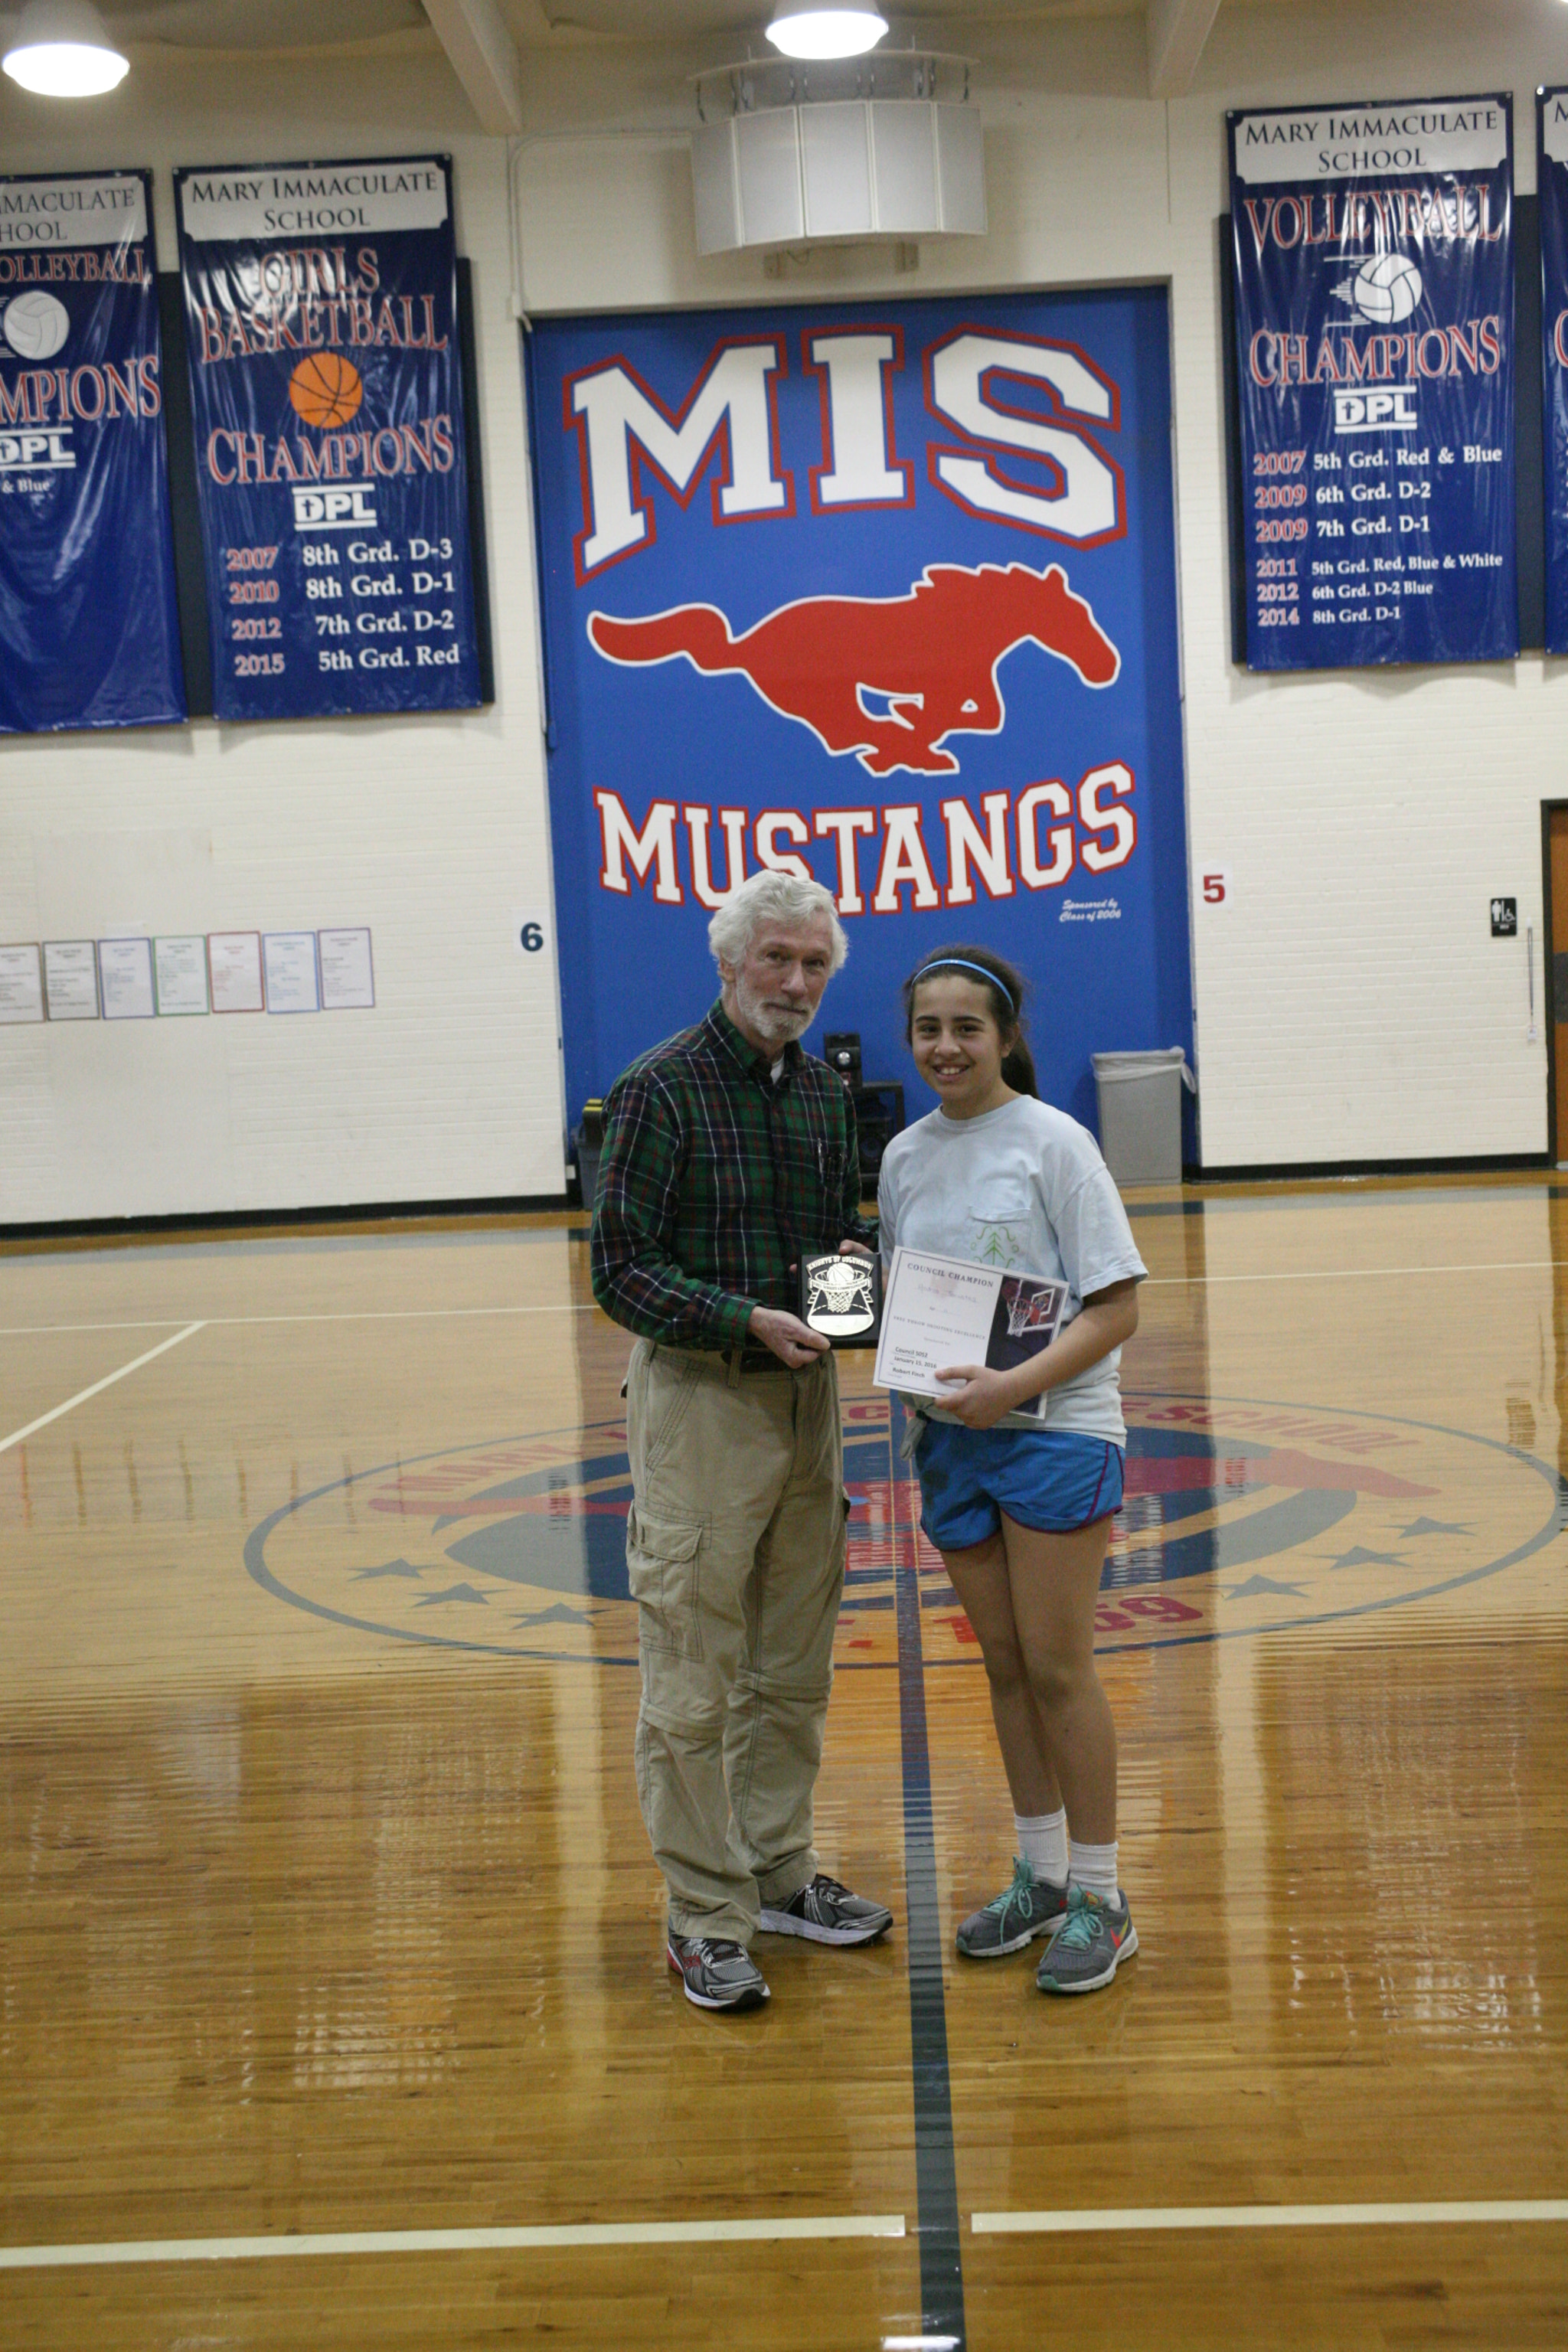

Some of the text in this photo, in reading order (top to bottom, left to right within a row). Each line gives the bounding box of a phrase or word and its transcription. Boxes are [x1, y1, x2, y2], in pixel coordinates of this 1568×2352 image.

[1246, 110, 1498, 145] MARY IMMACULATE
[1318, 148, 1426, 173] SCHOOL
[0, 188, 136, 214] MACULATE
[192, 172, 438, 203] MARY IMMACULATE
[264, 207, 371, 231] SCHOOL
[1244, 185, 1501, 255] VOLLEYBALL
[260, 247, 380, 297] GIRLS
[201, 295, 449, 364] BASKETBALL
[1250, 315, 1501, 387] CHAMPIONS
[1334, 394, 1417, 425] DPL
[207, 414, 455, 485] CHAMPIONS
[563, 322, 1128, 590] MIS
[1253, 445, 1502, 475] 2007 5th Grd. Red & Blue
[2, 479, 51, 493] & Blue
[1255, 482, 1431, 509] 2009 6th Grd. D-2
[294, 492, 377, 522] DPL
[1256, 515, 1430, 543] 2009 7th Grd. D-1
[227, 538, 454, 571] 2007 8th Grd. D-3
[1256, 553, 1503, 577] 2011 5th Grd. Red, Blue & White
[229, 571, 456, 604] 2010 8th Grd. D-1
[1256, 580, 1433, 603] 2012 6th Grd. D-2 Blue
[232, 609, 455, 640] 2012 7th Grd. D-2
[1258, 606, 1401, 627] 2014 8th Grd. D-1
[234, 644, 460, 677] 2015 5th Grd. Red
[593, 759, 1137, 916] MUSTANGS
[1203, 874, 1226, 903] 5
[521, 922, 544, 952] 6
[907, 1263, 994, 1287] COUNCIL CHAMPION
[893, 1367, 910, 1375] Robert
[911, 1370, 925, 1378] Finch
[894, 1356, 914, 1366] January
